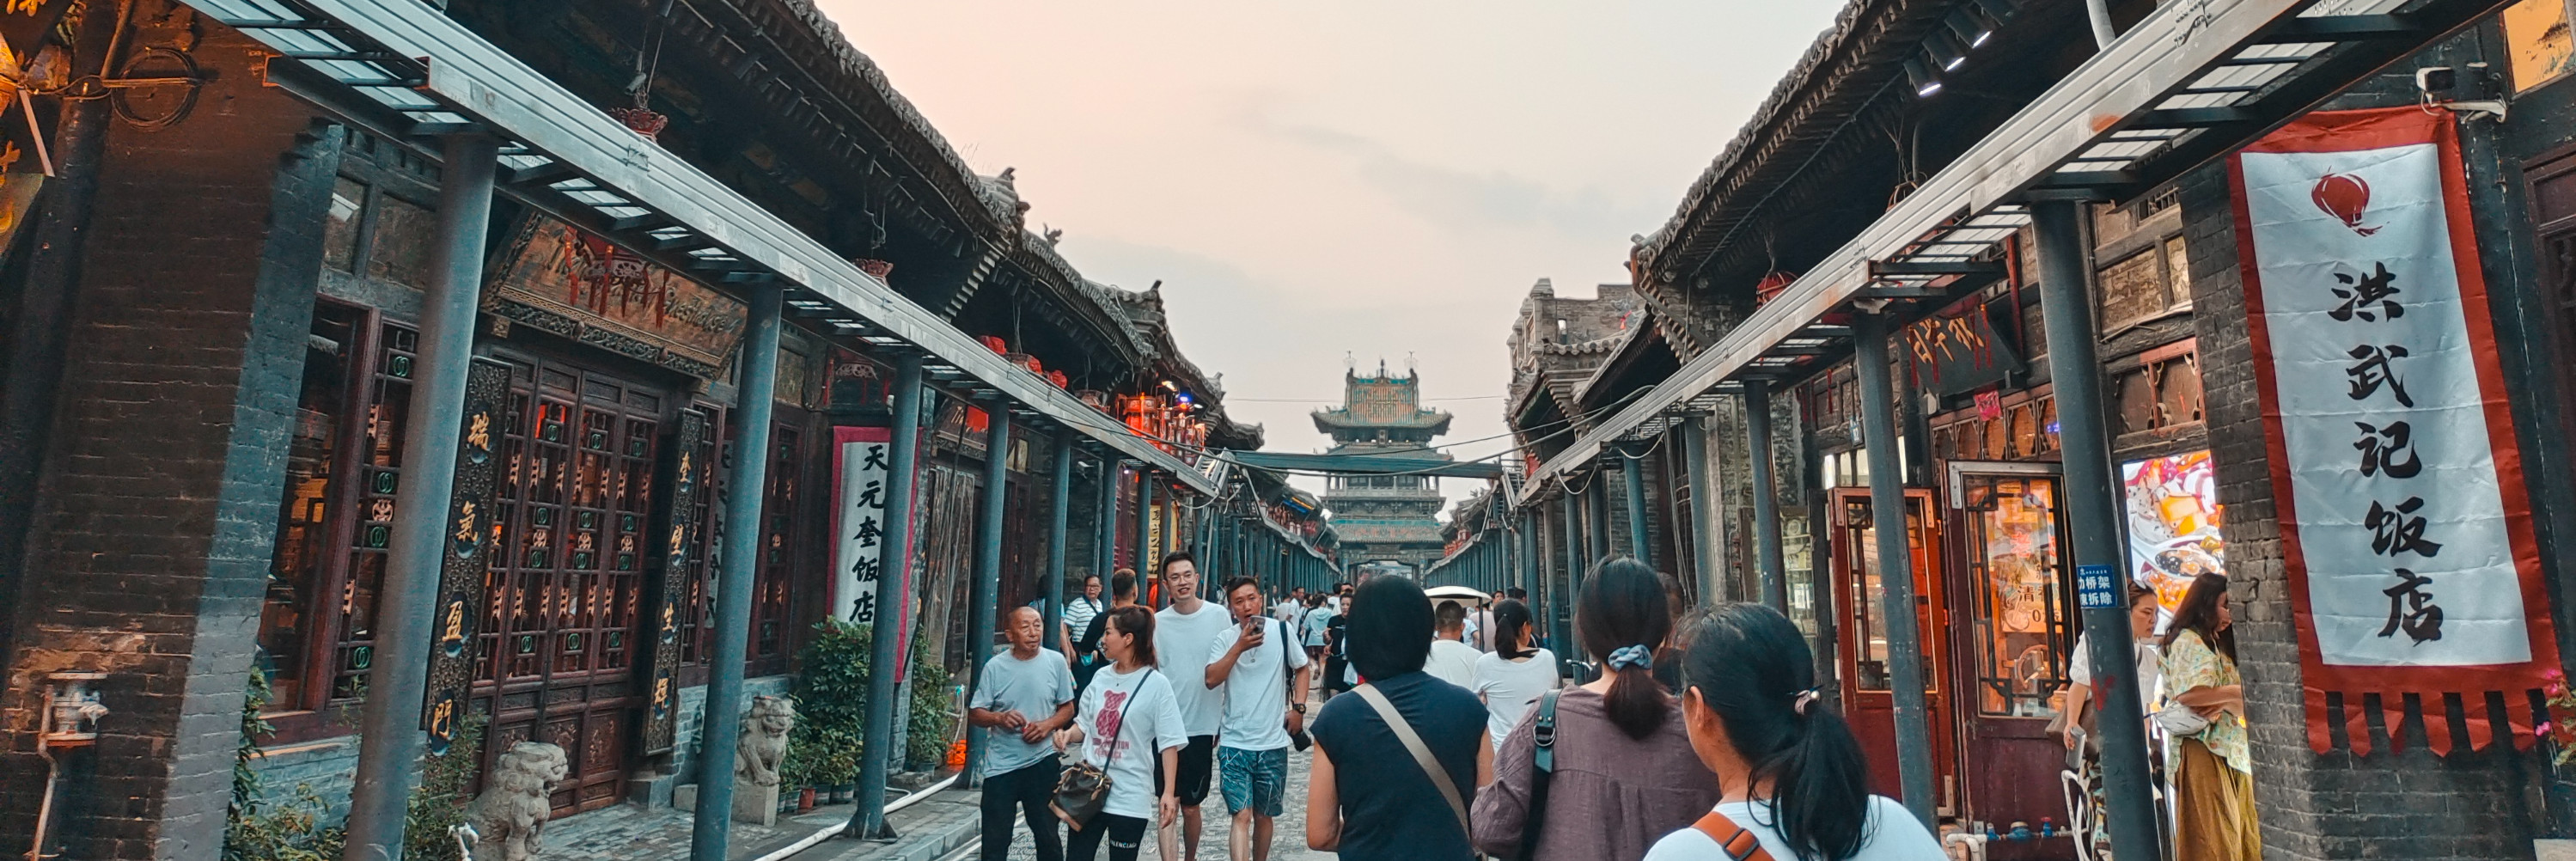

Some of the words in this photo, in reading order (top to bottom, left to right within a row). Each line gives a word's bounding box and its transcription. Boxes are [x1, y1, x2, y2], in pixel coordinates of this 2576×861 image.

[849, 444, 888, 623] 天元奎饭店
[2328, 261, 2445, 648] 洪武记饭店
